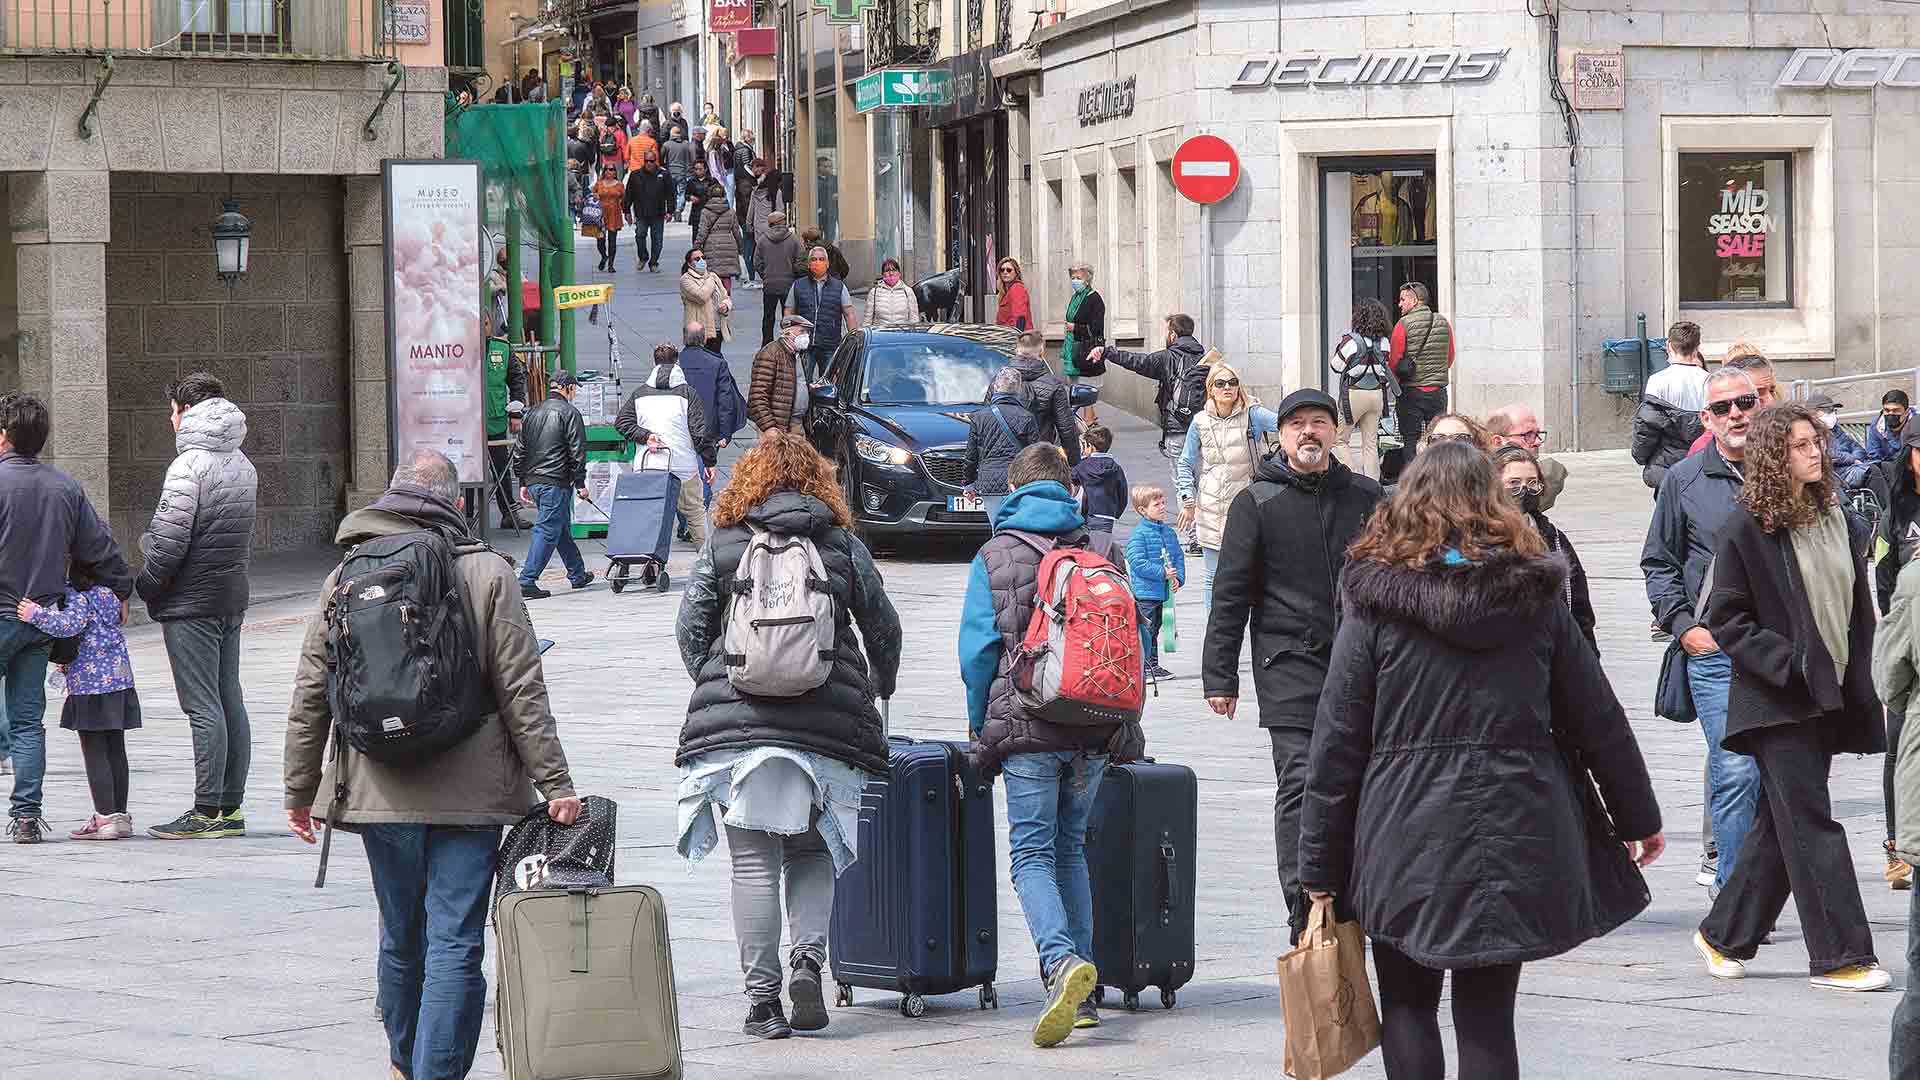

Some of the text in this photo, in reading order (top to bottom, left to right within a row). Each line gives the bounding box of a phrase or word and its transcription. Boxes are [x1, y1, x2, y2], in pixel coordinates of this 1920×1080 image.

[1230, 48, 1511, 88] DECIMAS
[1078, 73, 1137, 121] DECIMAS
[417, 188, 458, 197] MUSEO
[1720, 181, 1769, 214] MID
[1707, 213, 1777, 234] SEASON
[1715, 234, 1765, 257] SALE
[571, 289, 600, 300] ONCE
[410, 344, 464, 359] MANTO
